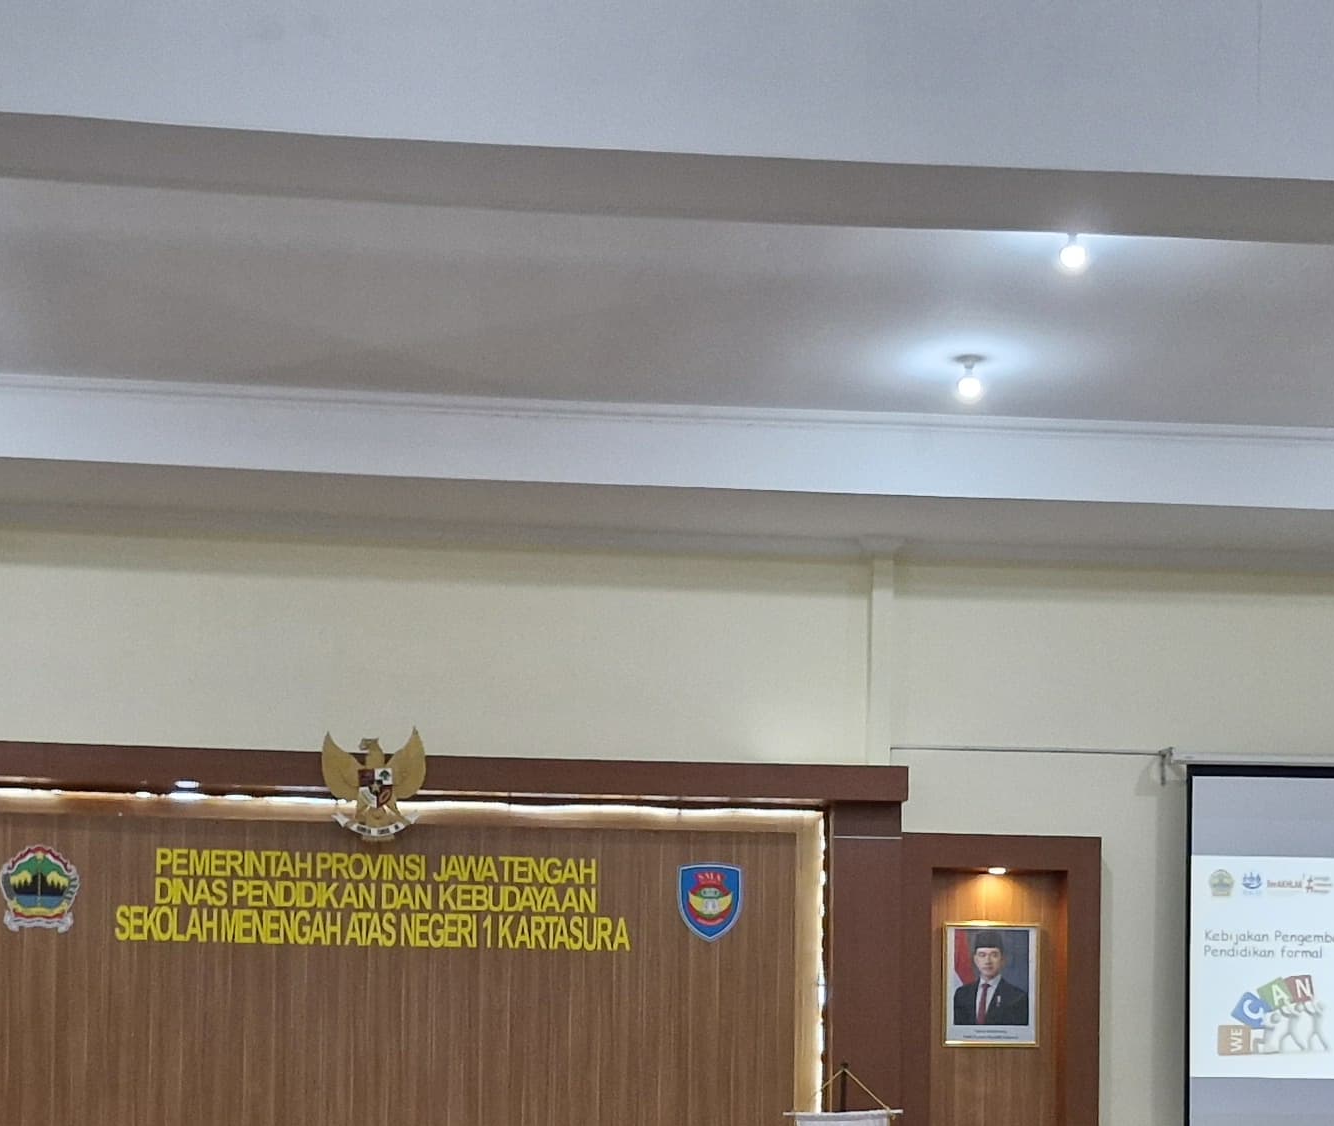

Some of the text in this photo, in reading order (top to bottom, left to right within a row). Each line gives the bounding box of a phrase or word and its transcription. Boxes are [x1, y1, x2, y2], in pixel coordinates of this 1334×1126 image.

[156, 848, 597, 885] PEMERINTAH PROVINSI JAWA TENGAH
[154, 877, 597, 913] DINAS PENDIDIKAN DAN KEBUDAYAAN
[115, 906, 631, 952] SEKOLAH MENENGAH ATAS NEGERI 1 KARTASURA
[1204, 930, 1269, 945] Kebijakan
[1203, 945, 1275, 958] Pendidikan
[1230, 1027, 1243, 1052] WE
